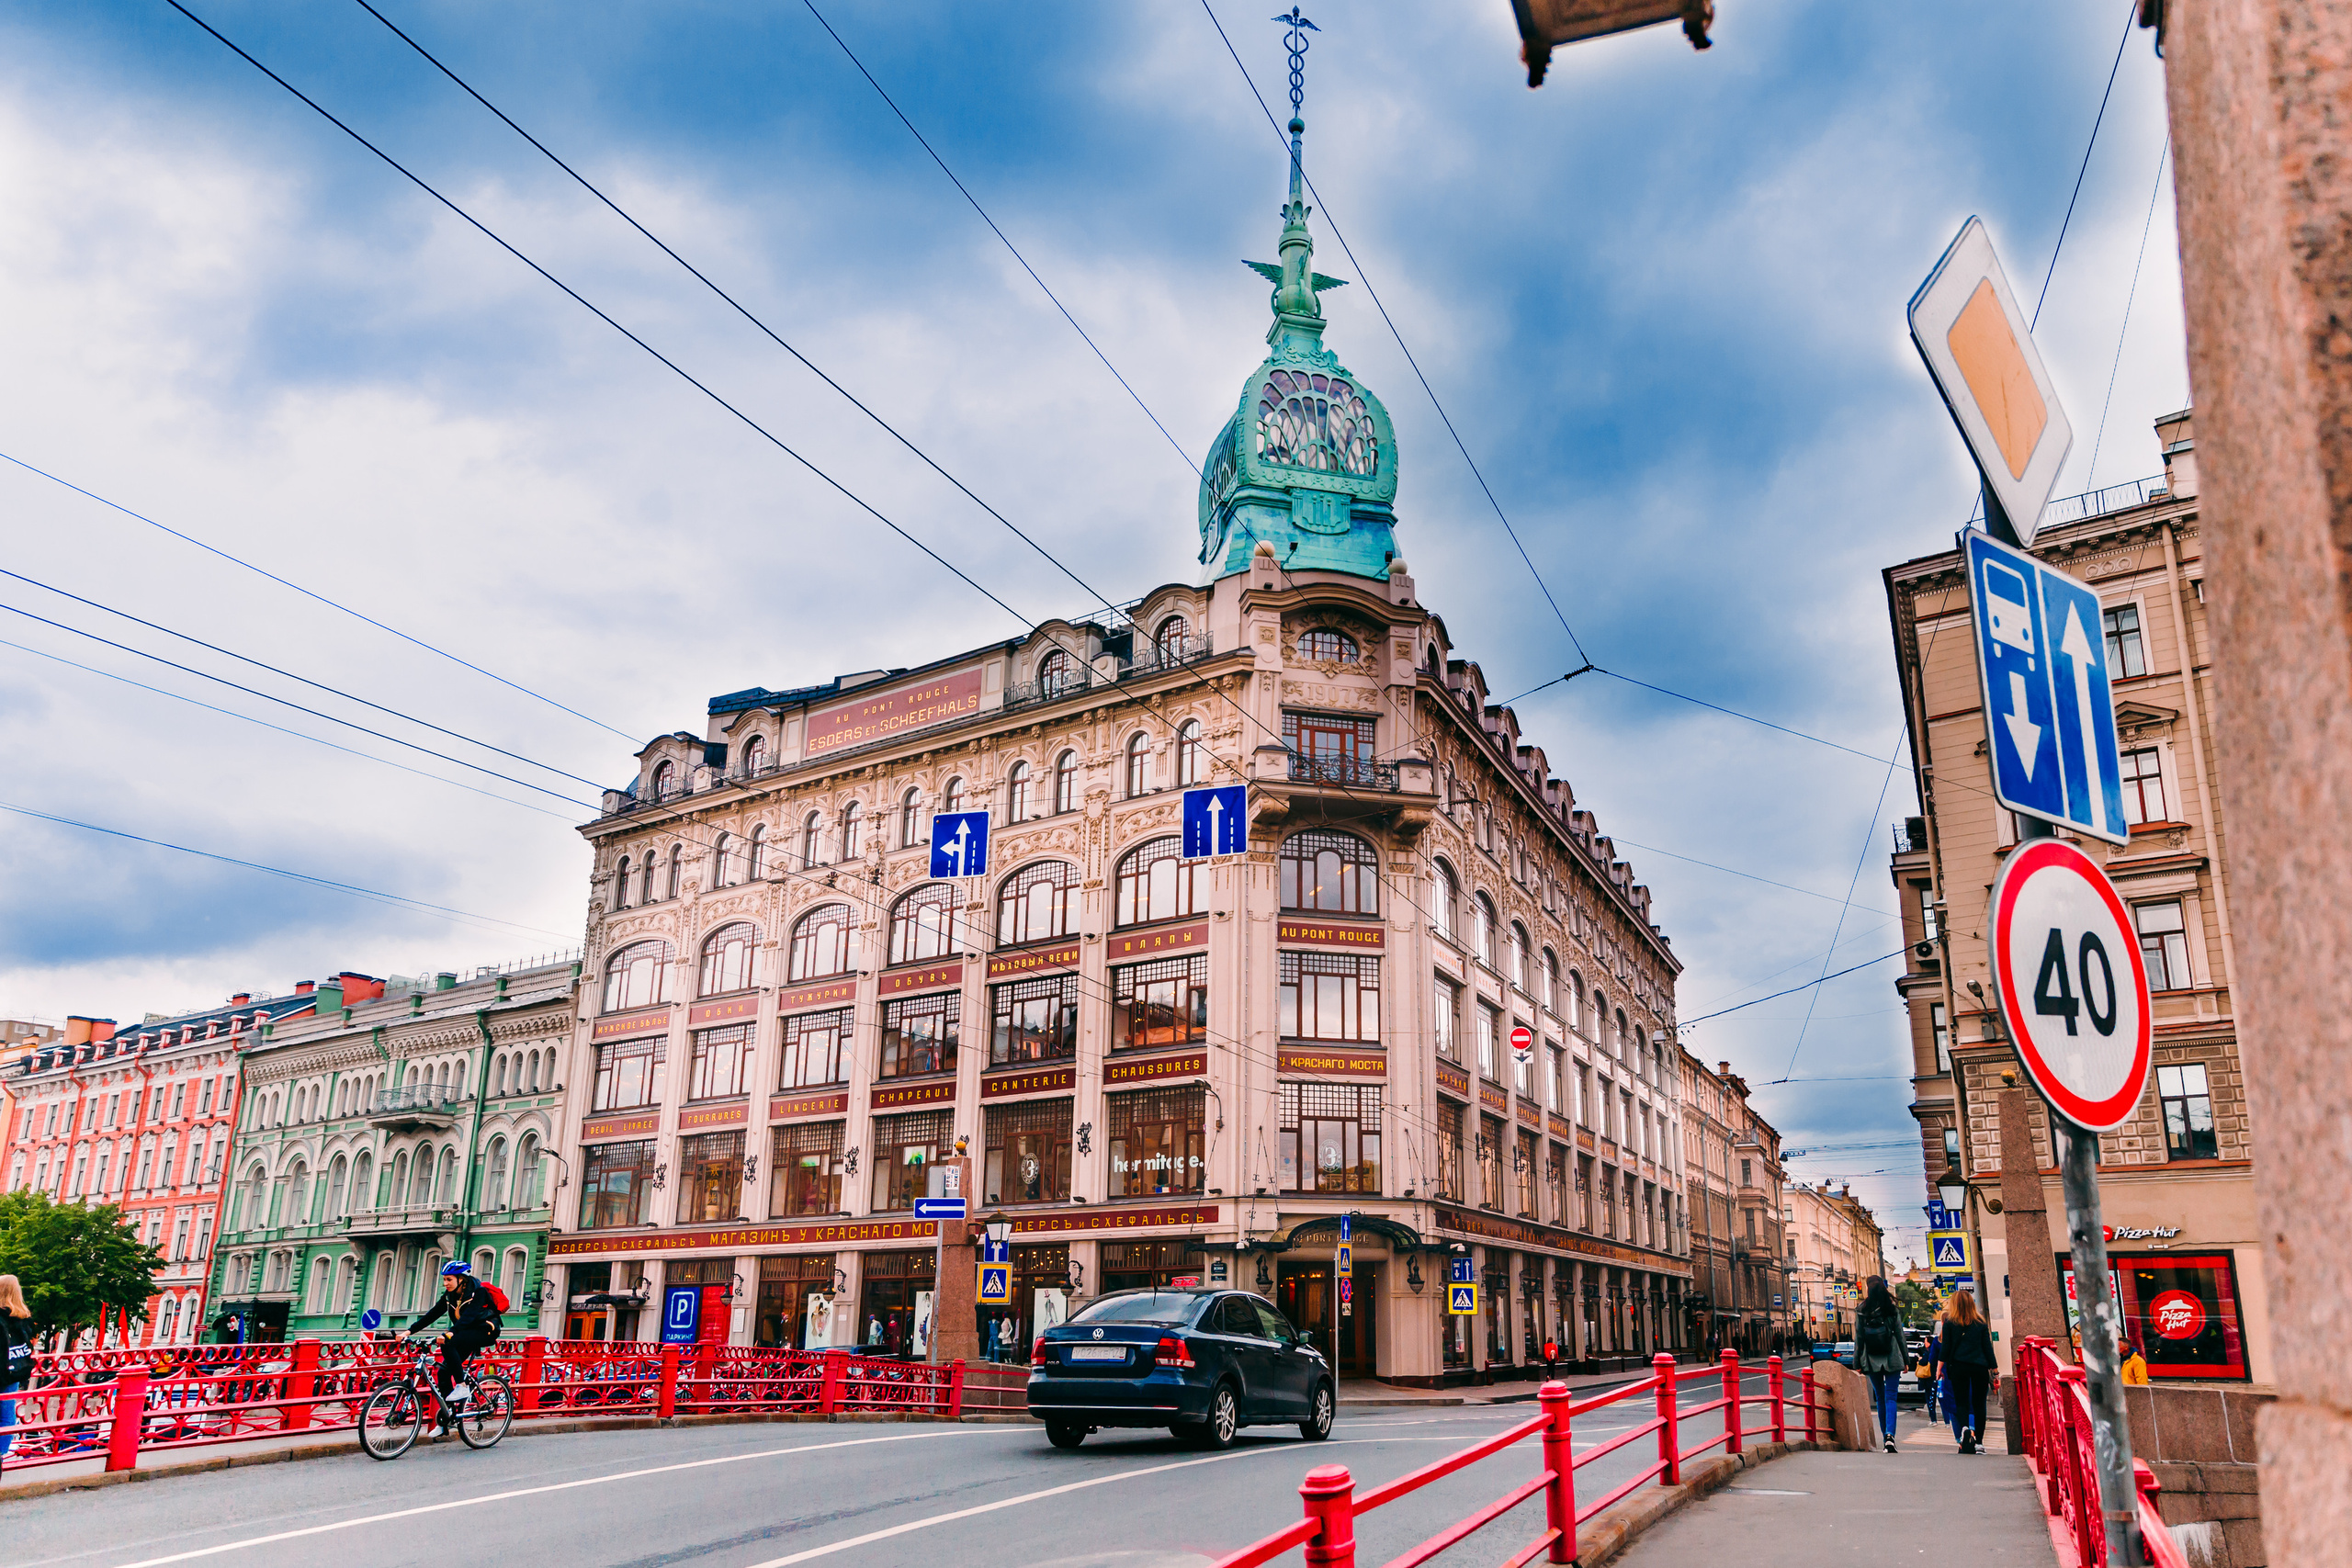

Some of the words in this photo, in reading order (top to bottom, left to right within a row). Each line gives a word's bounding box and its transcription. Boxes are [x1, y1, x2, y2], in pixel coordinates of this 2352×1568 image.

[836, 713, 850, 724] AU
[864, 700, 894, 716] PONT
[909, 685, 950, 704] ROUGE
[808, 726, 863, 751] ESDERS
[865, 724, 876, 737] ET
[879, 694, 978, 733] SCHEEFHALS
[1125, 931, 1193, 952] ШЛЯПЫ
[1281, 927, 1297, 938] AU
[1301, 928, 1333, 941] PONT
[1339, 931, 1380, 942] ROUGE
[1048, 950, 1078, 963] ВЕЩИ
[895, 972, 947, 988] ОБУВЬ
[2033, 927, 2118, 1037] 40
[790, 987, 847, 1004] ТУЖУРКИ
[1112, 1058, 1201, 1078] CHAUSSURES
[1290, 1057, 1345, 1069] КРАСНАГО
[1350, 1060, 1384, 1071] МОСТА
[879, 1087, 950, 1103] CHAPEAUX
[687, 1110, 741, 1124] FOURRURES
[707, 1164, 719, 1217] 欢迎光
[1014, 1218, 1073, 1233] ДЕРСЪ
[1091, 1213, 1205, 1229] СХЕФАЛЬСЪ
[553, 1242, 608, 1253] ЭСДЕРСЪ
[621, 1237, 696, 1251] СХЕФАЛЬСЪ
[709, 1229, 791, 1246] МАГАЗИНЪ
[799, 1229, 807, 1242] У
[816, 1224, 902, 1240] КРАСНАГО
[1336, 1233, 1370, 1244] RUGE
[2114, 1225, 2152, 1240] Pizza
[2152, 1225, 2181, 1238] Hut
[676, 1298, 687, 1322] P
[2159, 1310, 2192, 1323] Pizza
[2165, 1318, 2191, 1331] Hut
[665, 1333, 694, 1341] ПАРКИНГ
[9, 1343, 31, 1359] ANS
